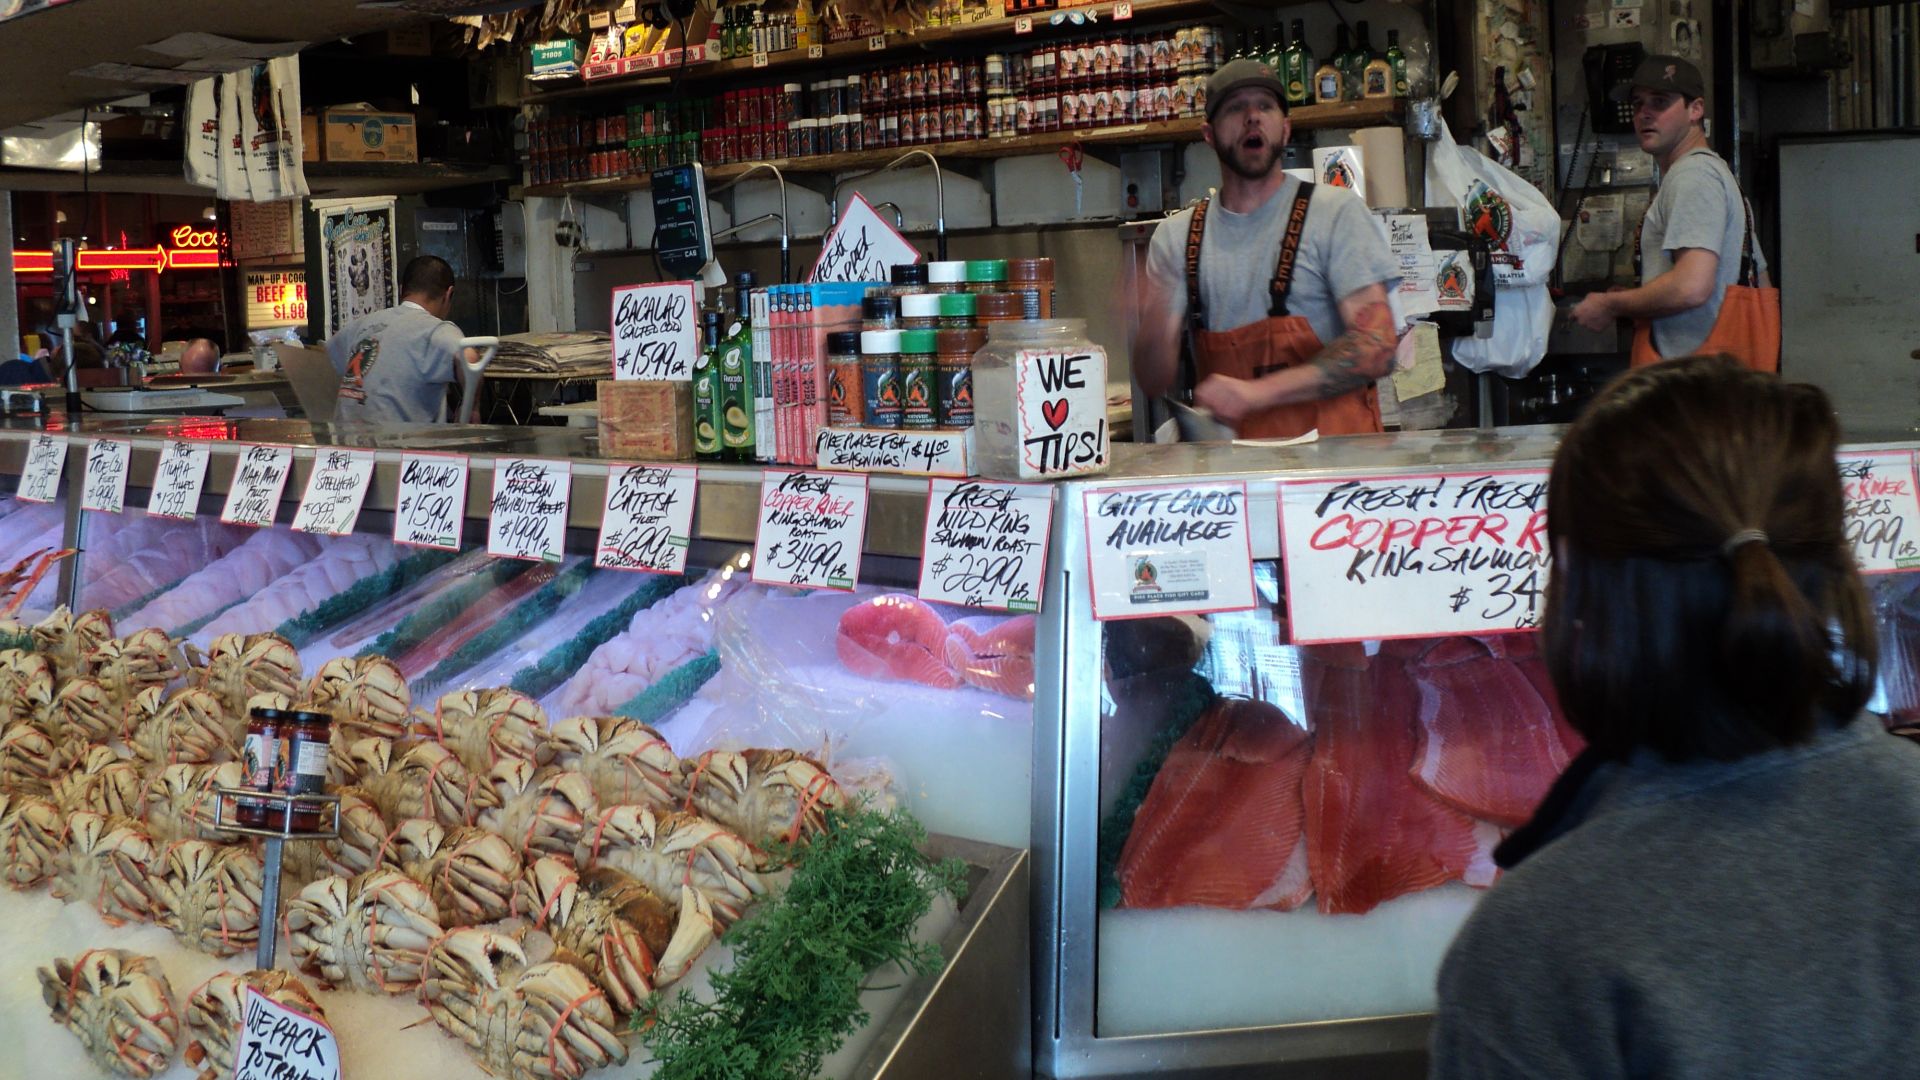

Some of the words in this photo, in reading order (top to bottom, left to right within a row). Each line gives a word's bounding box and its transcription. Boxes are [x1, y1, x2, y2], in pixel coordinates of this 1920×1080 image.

[971, 7, 993, 22] Garlic
[684, 249, 697, 258] CAS
[248, 273, 280, 285] MAN-UP
[256, 285, 286, 303] BEEF
[614, 293, 686, 327] BACALAO
[723, 374, 743, 383] Avocado
[1036, 353, 1091, 393] WE
[816, 431, 843, 455] PIKE
[844, 433, 880, 449] PLACE
[879, 432, 911, 450] FISH
[1024, 418, 1105, 474] TIPS!
[402, 459, 460, 491] BACALAO
[504, 459, 550, 483] FRESH
[619, 465, 679, 489] FRESH
[779, 470, 841, 495] FRESH
[505, 477, 558, 499] ALASKAN
[608, 484, 679, 518] CATFISH
[943, 480, 1023, 512] FRESH
[1314, 477, 1447, 518] FRESH!
[490, 490, 533, 518] HALIBUT
[764, 487, 816, 513] COPPER
[814, 492, 856, 518] RIVER
[1097, 491, 1173, 519] GIFT
[1167, 487, 1245, 519] CARDS
[766, 509, 800, 527] KING
[799, 510, 849, 531] SALMON
[788, 526, 828, 541] ROAST
[936, 508, 987, 531] WILD
[985, 508, 1032, 535] KING
[1105, 517, 1240, 551] AVAILABLE
[1309, 513, 1509, 554] COPPER
[930, 528, 993, 552] SALMON
[991, 534, 1042, 556] ROAST
[1346, 545, 1423, 584] KING
[964, 593, 994, 608] USA
[246, 998, 277, 1038] WE
[268, 1016, 328, 1067] PACK
[245, 1041, 264, 1070] TO
